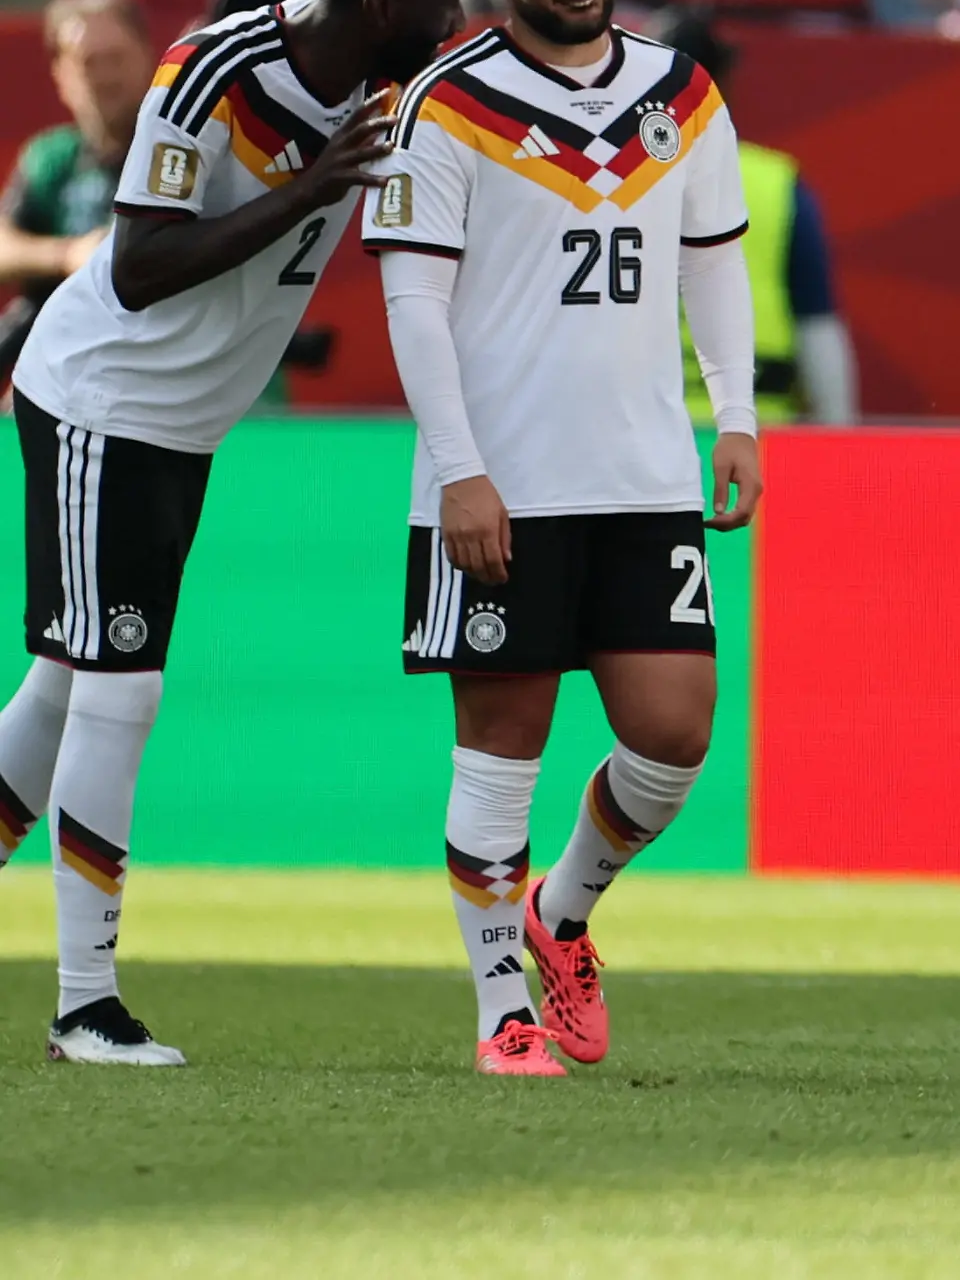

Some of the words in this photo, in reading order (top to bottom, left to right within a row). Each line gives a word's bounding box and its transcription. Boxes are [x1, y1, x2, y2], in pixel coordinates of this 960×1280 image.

[278, 217, 326, 286] 2
[561, 226, 643, 306] 26
[670, 545, 716, 627] 2
[104, 909, 122, 922] DF
[482, 925, 517, 944] DFB
